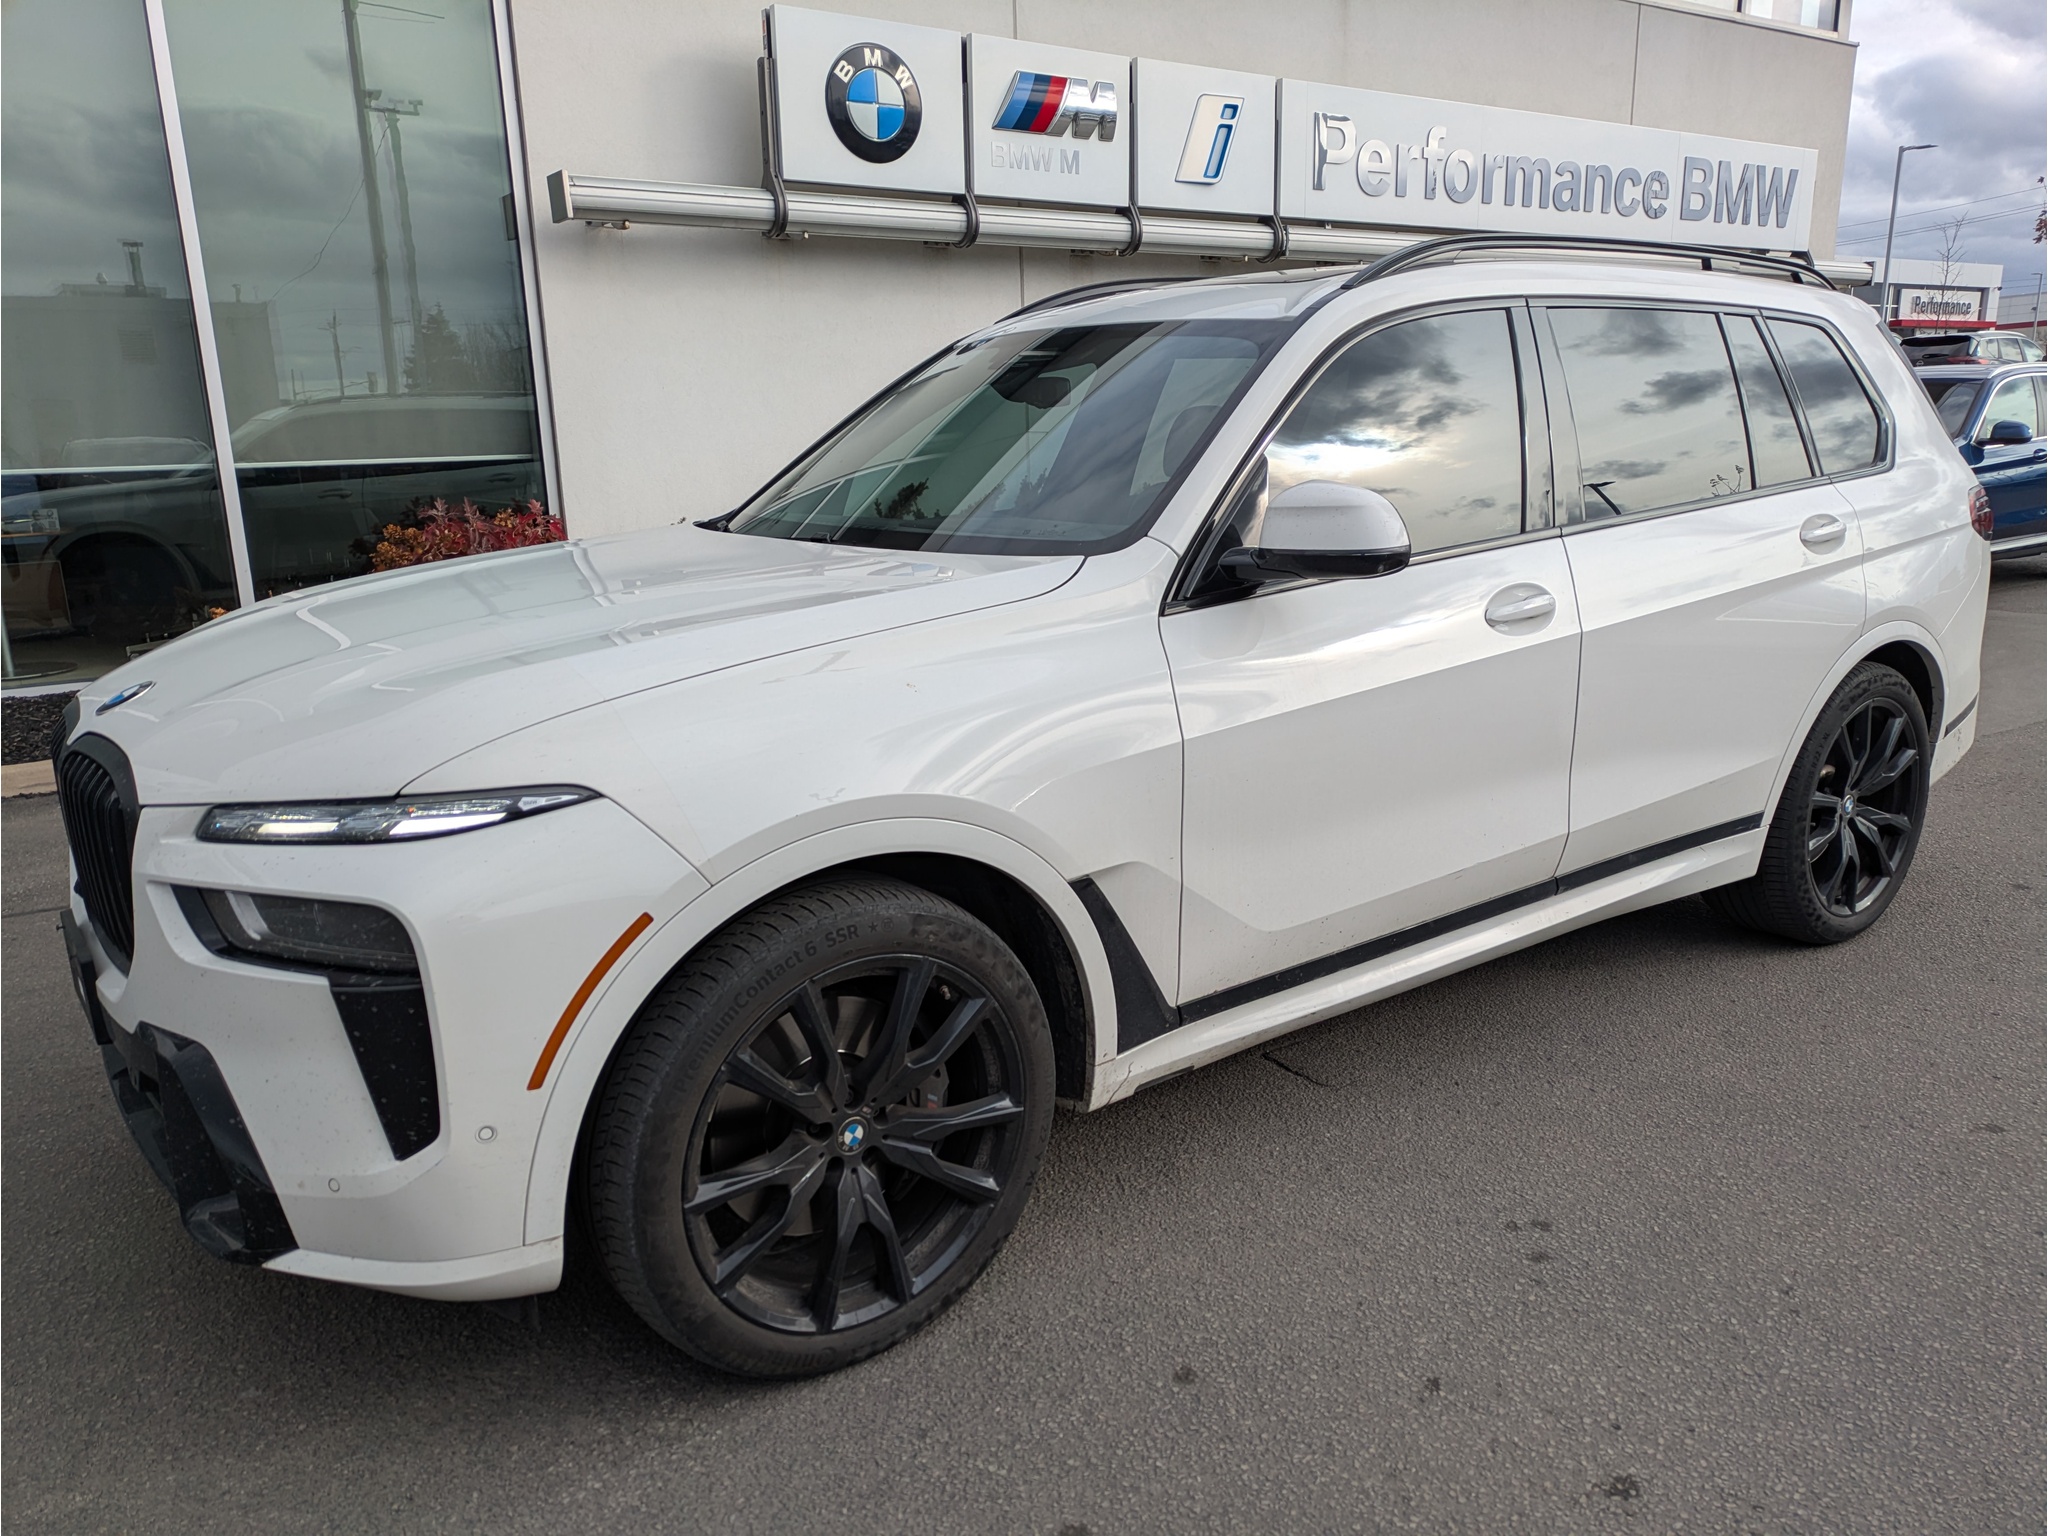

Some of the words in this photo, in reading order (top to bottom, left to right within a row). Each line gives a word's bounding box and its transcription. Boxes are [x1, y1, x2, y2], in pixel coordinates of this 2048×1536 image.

[990, 141, 1053, 173] BMW
[1060, 148, 1081, 175] M
[1312, 110, 1671, 220] Performance
[1680, 154, 1800, 229] BMW
[1913, 295, 1972, 315] Performance
[804, 940, 817, 957] 6
[824, 924, 860, 948] SSR
